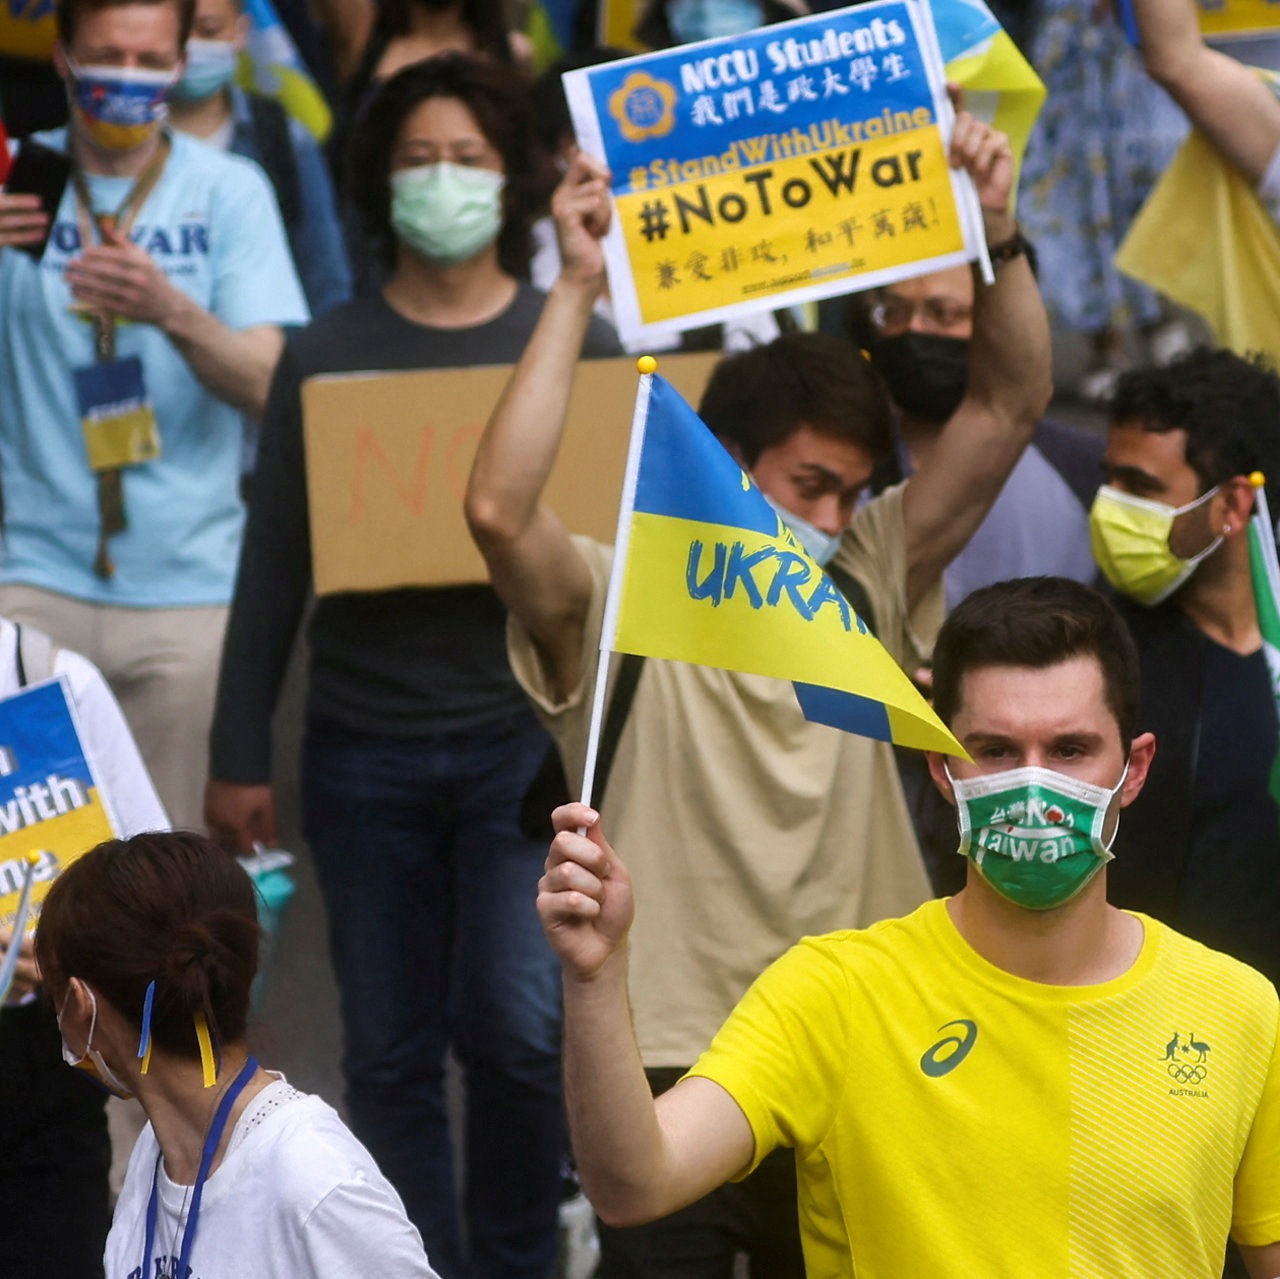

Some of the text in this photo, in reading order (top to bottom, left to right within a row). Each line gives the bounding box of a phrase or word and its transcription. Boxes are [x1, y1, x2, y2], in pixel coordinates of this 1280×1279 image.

[680, 17, 907, 94] NCCU Students
[690, 52, 912, 127] 我們是政大學生
[629, 106, 932, 190] #StandWithUkraine
[639, 148, 923, 242] #NoToWar
[975, 826, 1076, 865] Taiwan
[1169, 1088, 1209, 1099] AUSTRALIA
